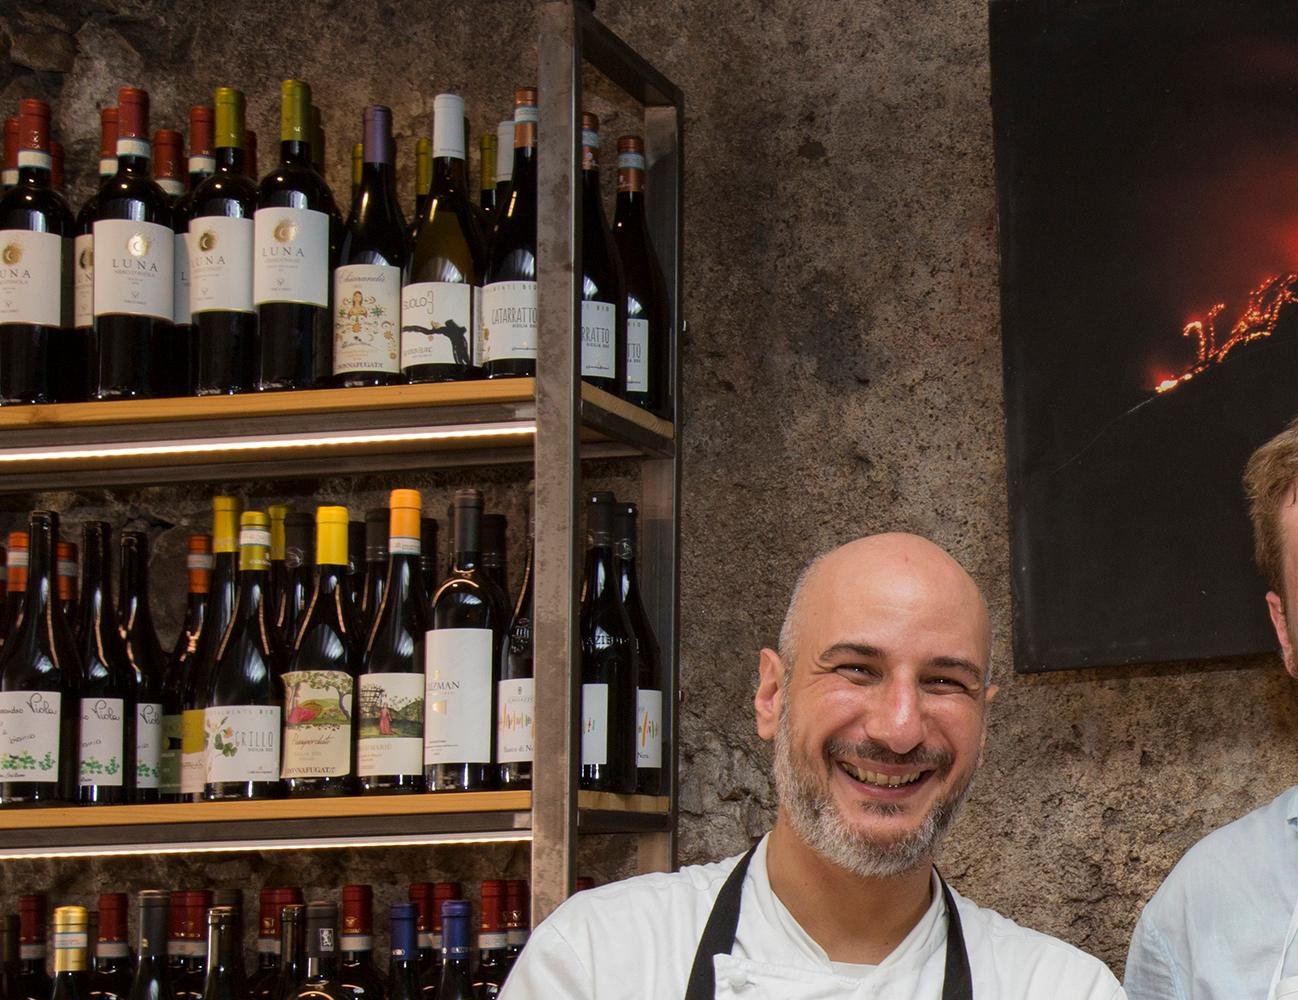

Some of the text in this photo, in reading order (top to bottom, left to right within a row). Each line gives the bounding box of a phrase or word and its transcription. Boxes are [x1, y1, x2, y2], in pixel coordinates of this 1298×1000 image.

[262, 247, 305, 258] LUNA
[112, 258, 158, 273] LUNA
[0, 269, 32, 279] UNA
[582, 326, 610, 345] RRATTO
[235, 731, 273, 748] GRILLO
